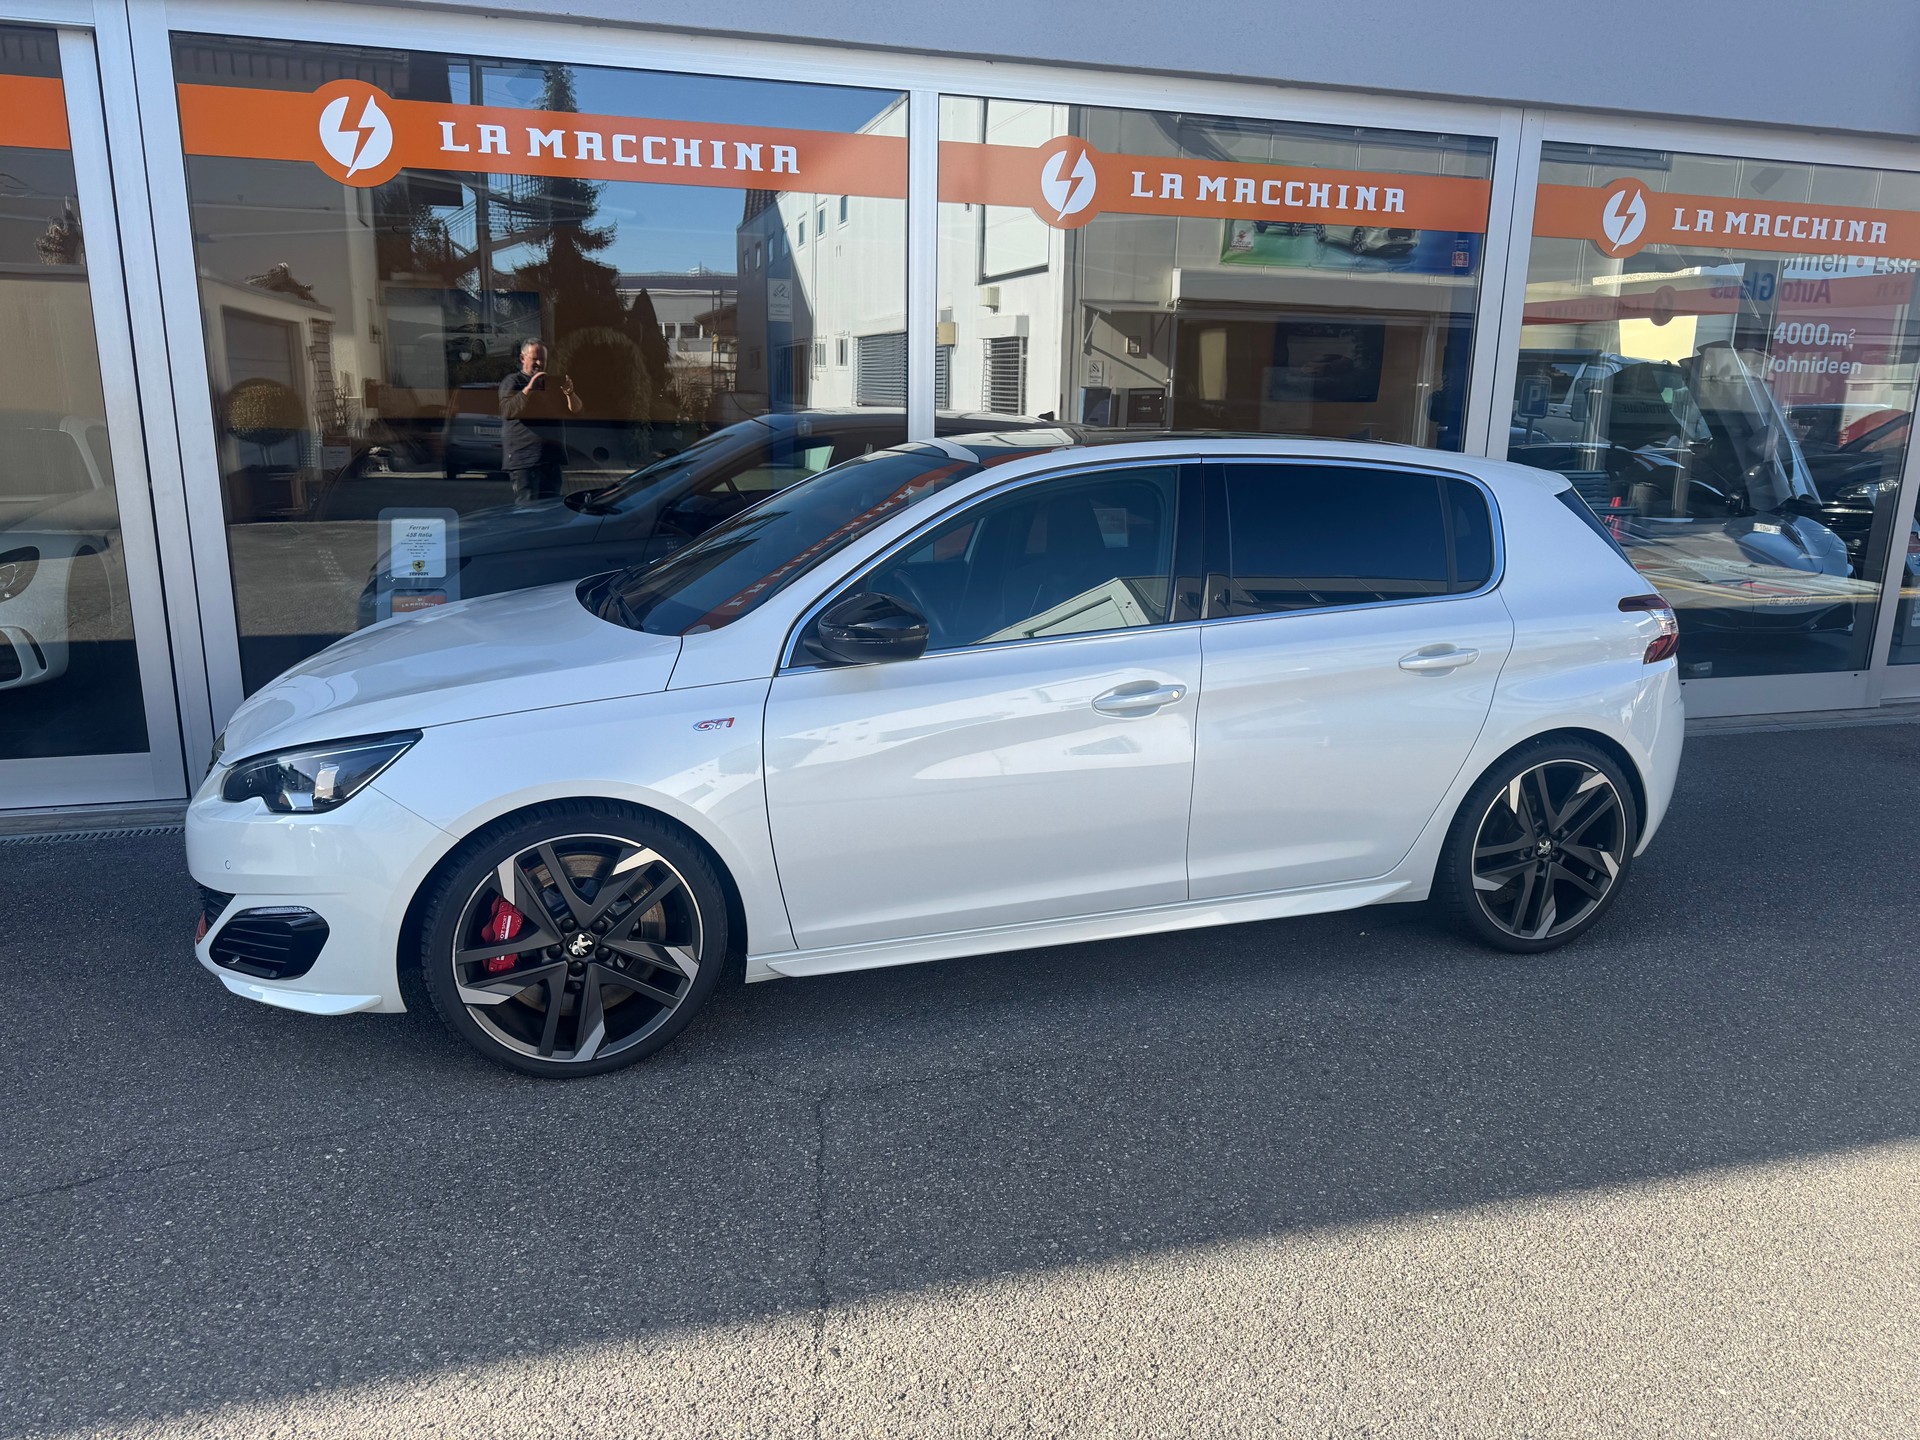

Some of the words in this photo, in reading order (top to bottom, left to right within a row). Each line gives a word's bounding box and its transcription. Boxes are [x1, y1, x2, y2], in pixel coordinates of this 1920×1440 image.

[439, 121, 511, 155] LA
[525, 127, 801, 175] MACCHINA
[1130, 171, 1185, 200] LA
[1195, 175, 1405, 213] MACCHINA
[1671, 207, 1714, 233] LA
[1722, 211, 1887, 244] MACCHINA
